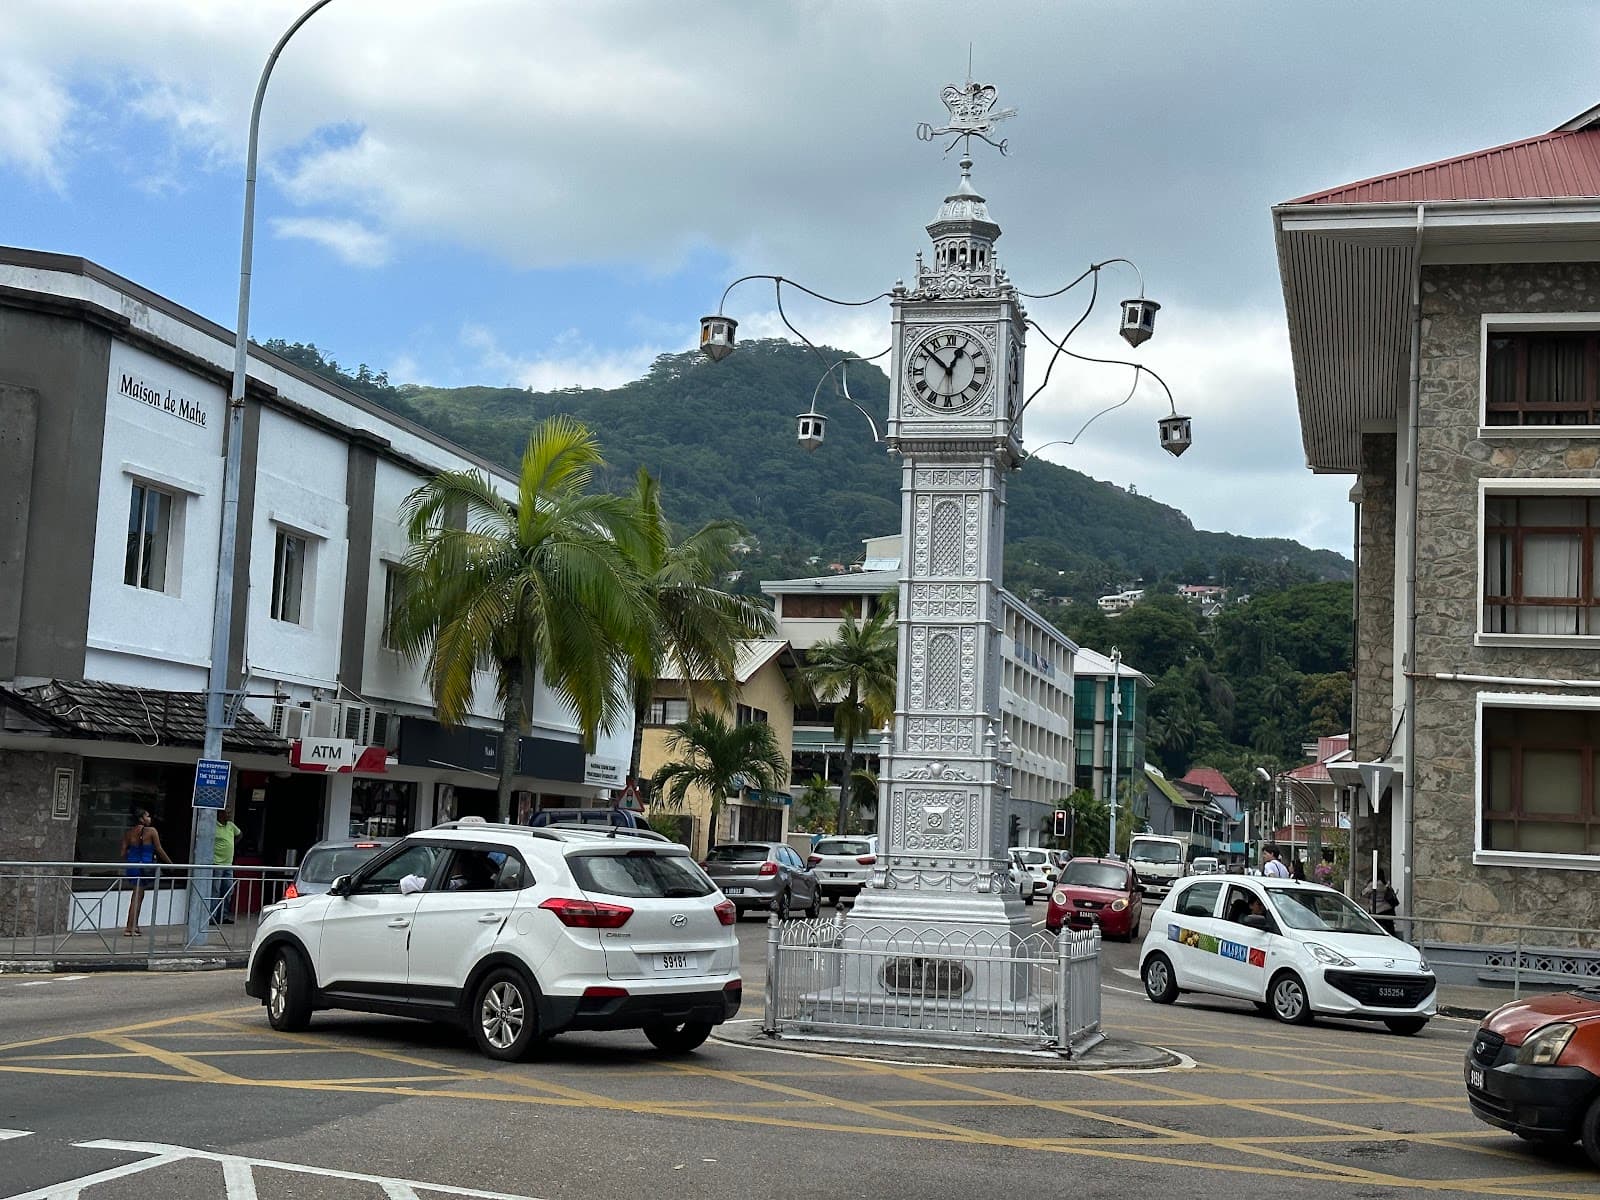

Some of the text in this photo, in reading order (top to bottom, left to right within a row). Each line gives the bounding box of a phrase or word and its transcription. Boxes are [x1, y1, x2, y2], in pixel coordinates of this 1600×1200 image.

[946, 335, 957, 346] XII
[120, 374, 206, 425] Maison de Mahe
[311, 745, 342, 759] ATM
